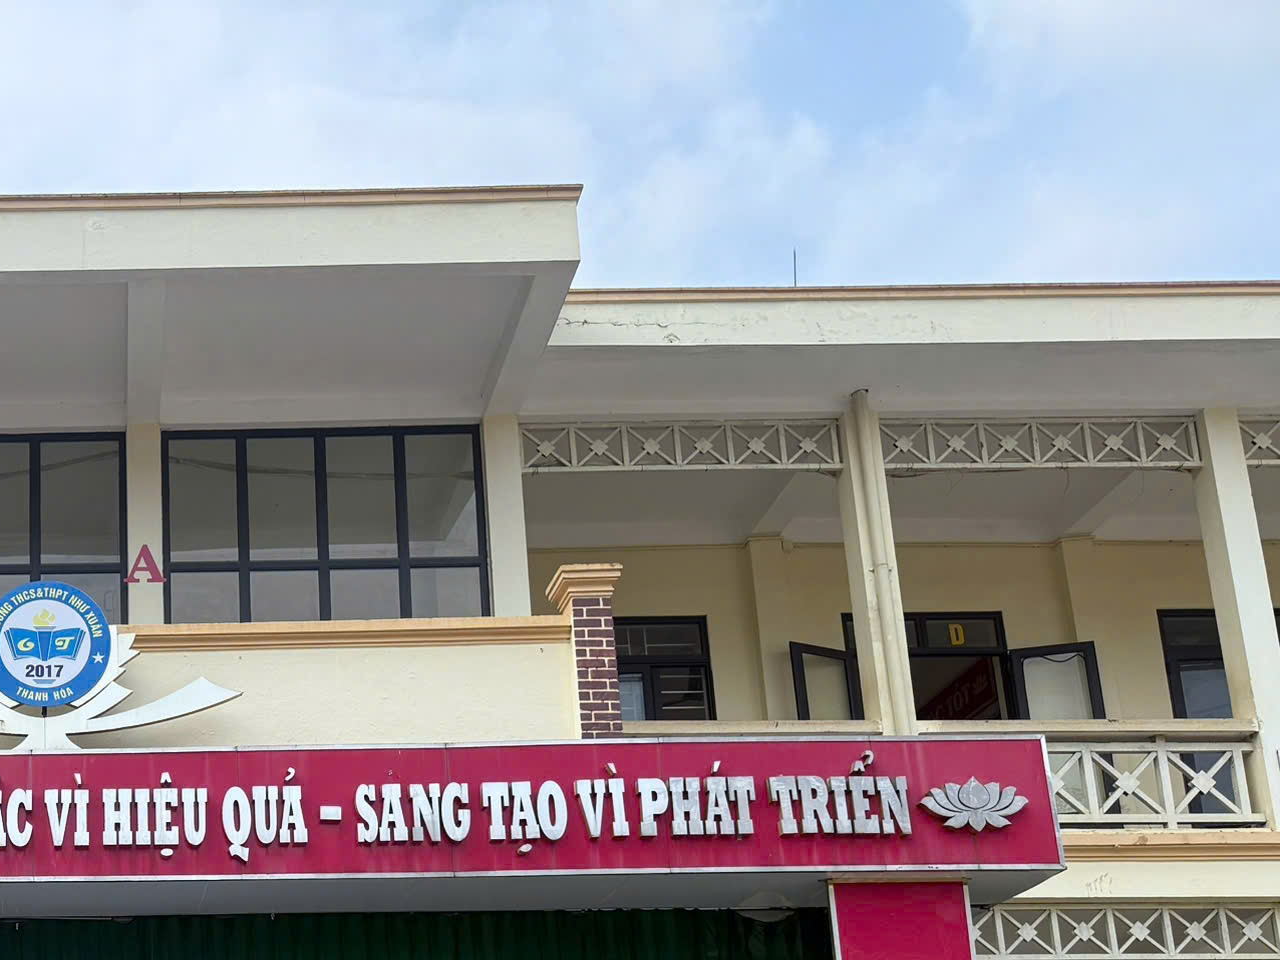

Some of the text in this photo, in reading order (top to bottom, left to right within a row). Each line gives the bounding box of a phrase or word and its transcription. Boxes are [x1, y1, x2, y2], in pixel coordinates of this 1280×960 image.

[123, 544, 167, 583] A
[11, 587, 69, 605] THCS&THPT
[68, 596, 91, 614] NHƯ
[948, 623, 965, 646] D
[25, 664, 64, 678] 2017
[16, 687, 49, 701] THANH
[45, 773, 90, 848] VÌ
[102, 772, 209, 857] HIỆU
[222, 767, 309, 862] QUẢ
[319, 805, 342, 821] -
[482, 779, 569, 855] TẠO
[574, 761, 631, 839] VÌ
[639, 760, 756, 838] PHÁT
[766, 750, 914, 837] TRIỂN
